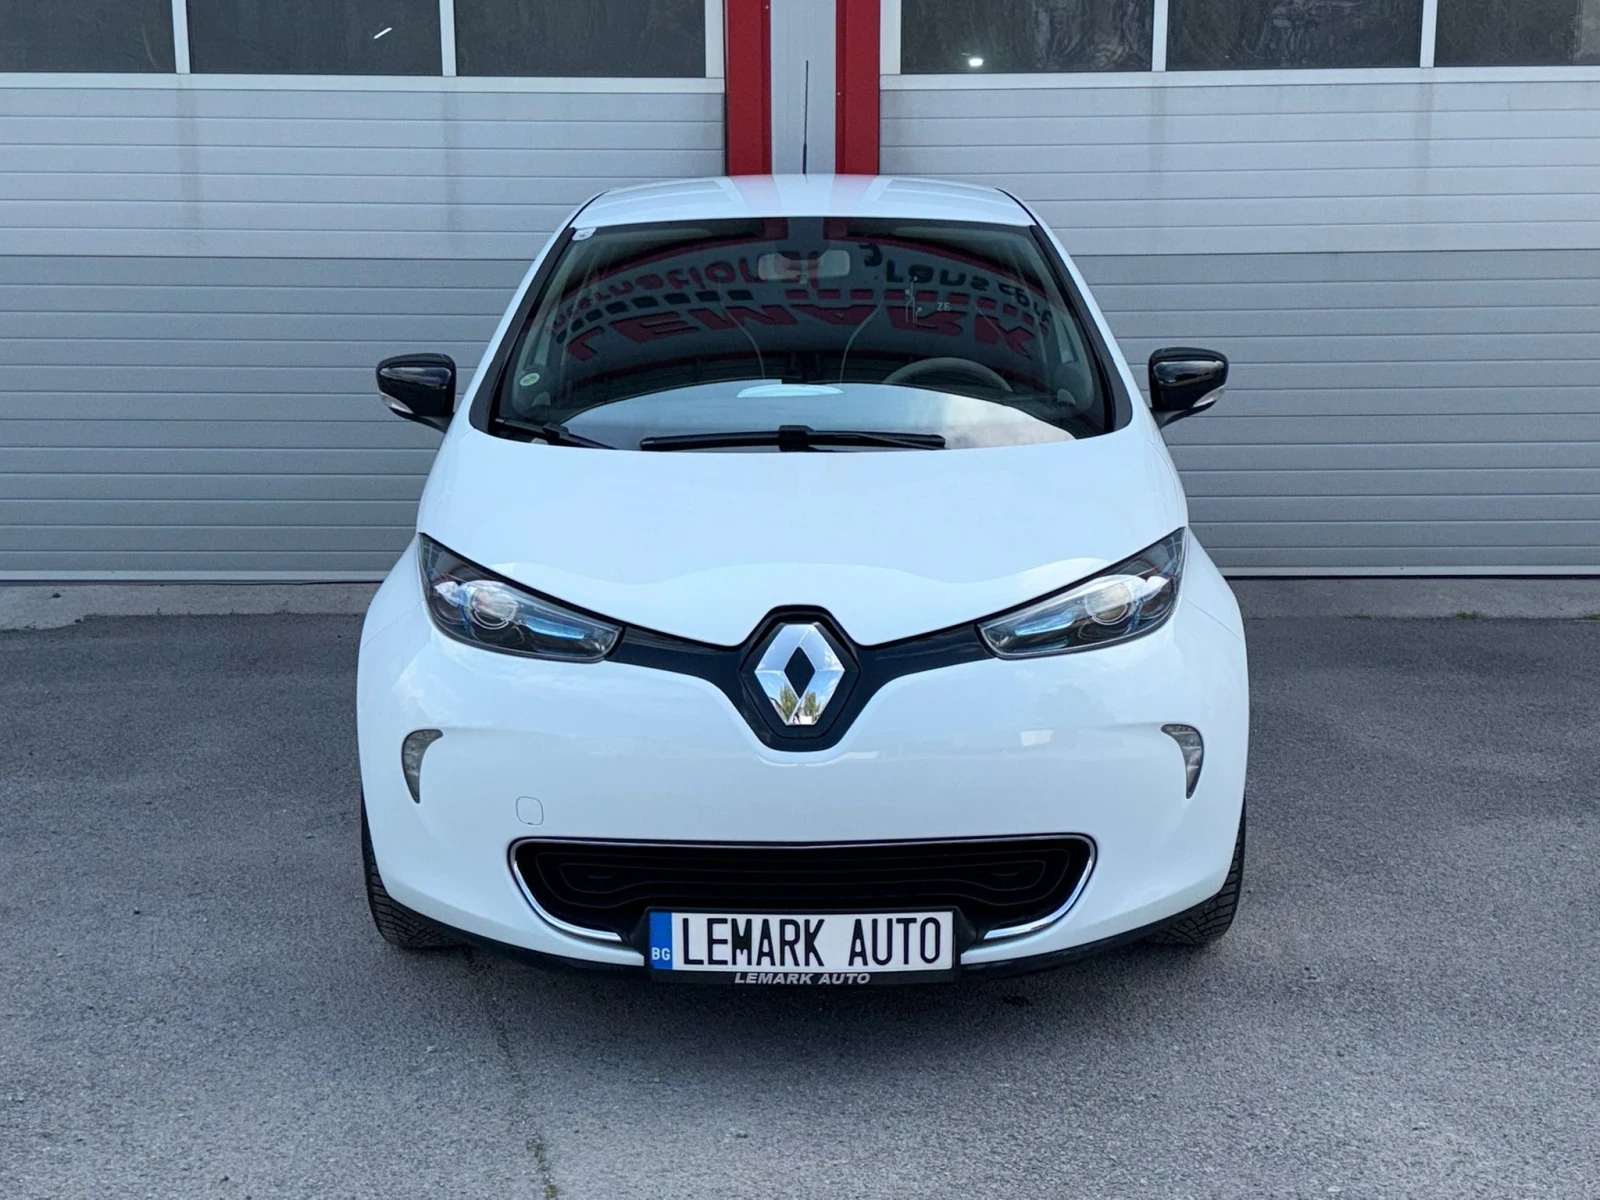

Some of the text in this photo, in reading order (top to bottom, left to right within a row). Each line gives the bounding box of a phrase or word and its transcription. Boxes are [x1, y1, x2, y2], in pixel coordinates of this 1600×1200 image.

[681, 916, 941, 967] LEMARK AUTO
[651, 947, 671, 961] BG
[734, 972, 871, 985] LEMARK AUTO
